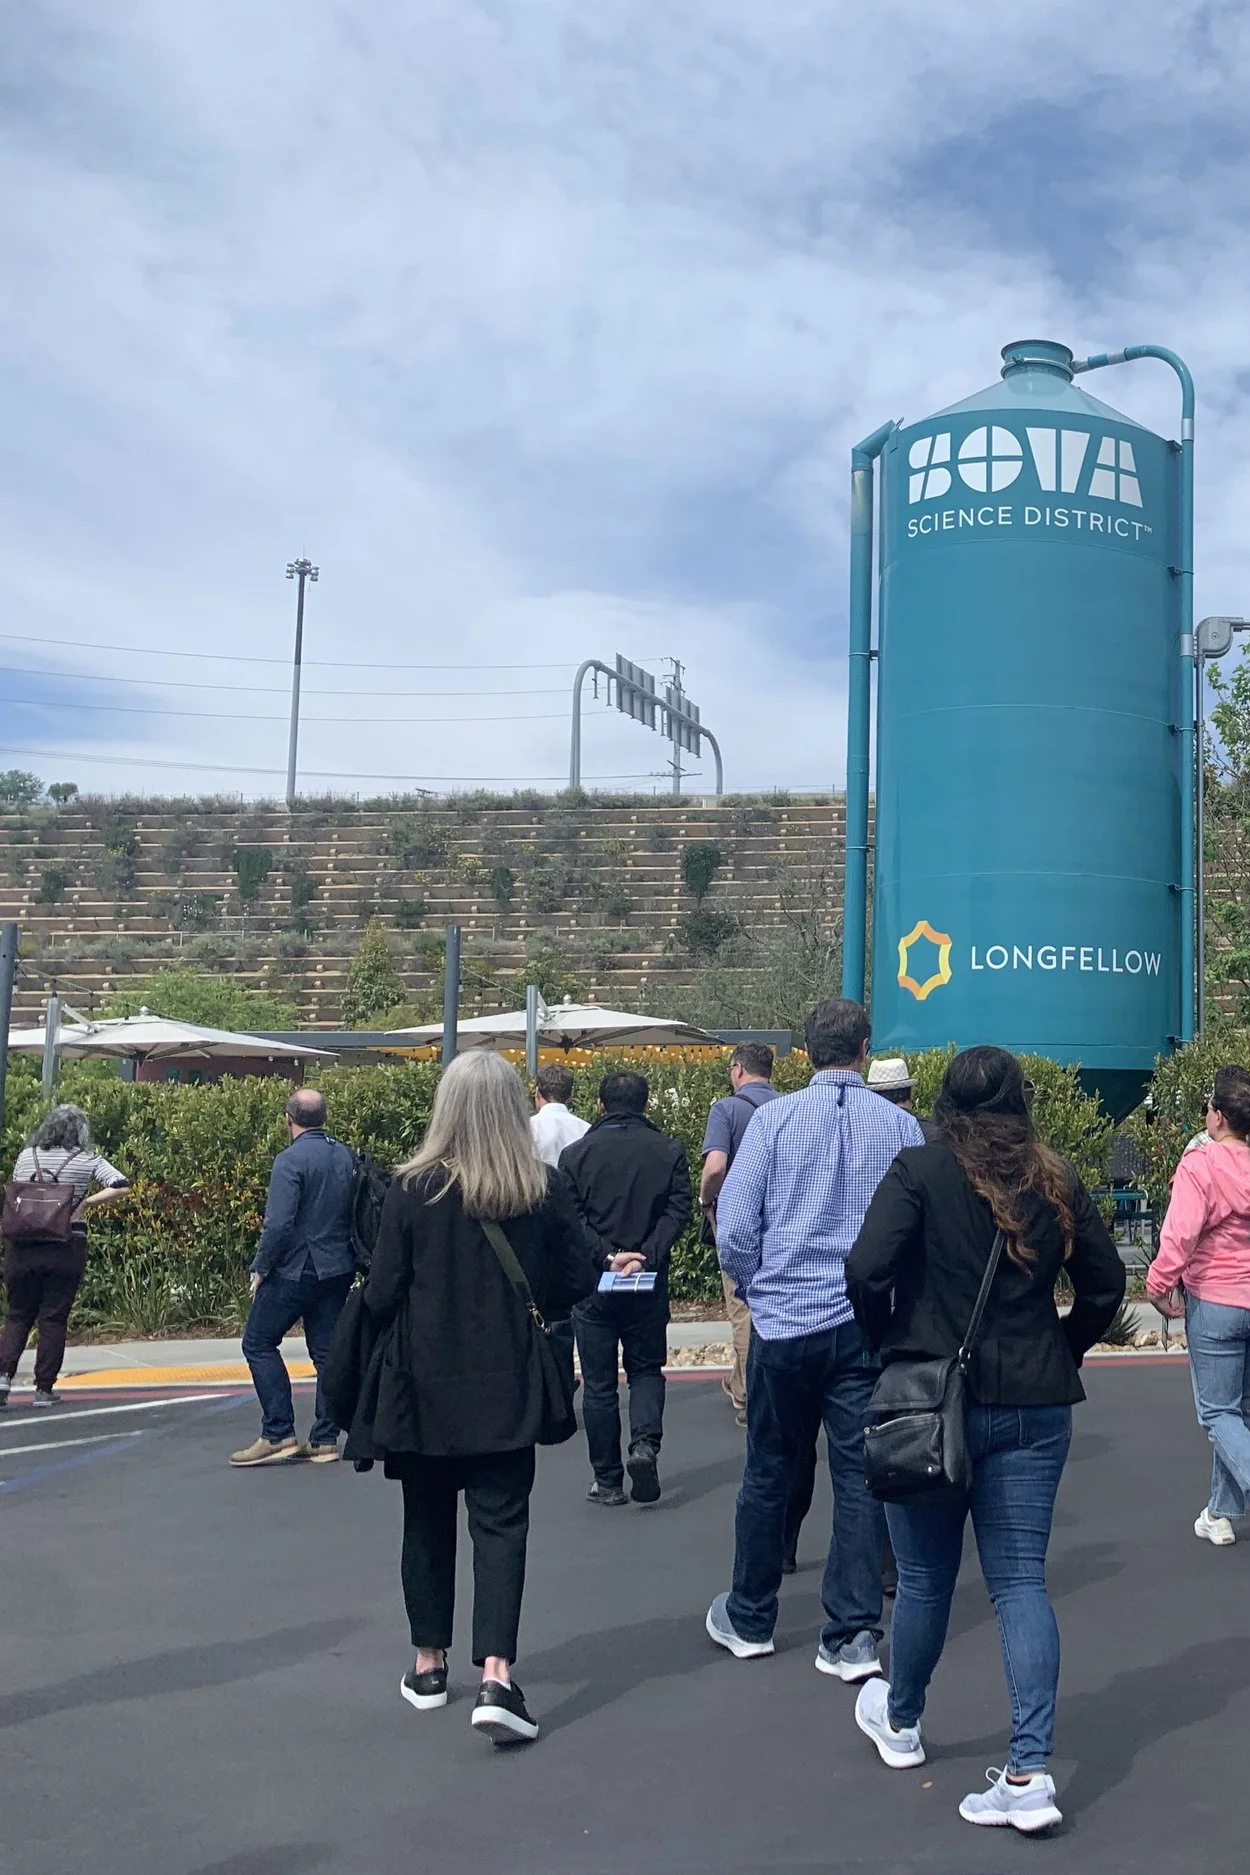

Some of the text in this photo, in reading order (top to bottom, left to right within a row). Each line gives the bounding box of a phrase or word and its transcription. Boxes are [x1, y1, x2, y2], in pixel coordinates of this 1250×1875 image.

[908, 425, 1143, 508] SOVA
[908, 506, 1013, 538] SCIENCE
[971, 945, 1162, 977] LONGFELLOW
